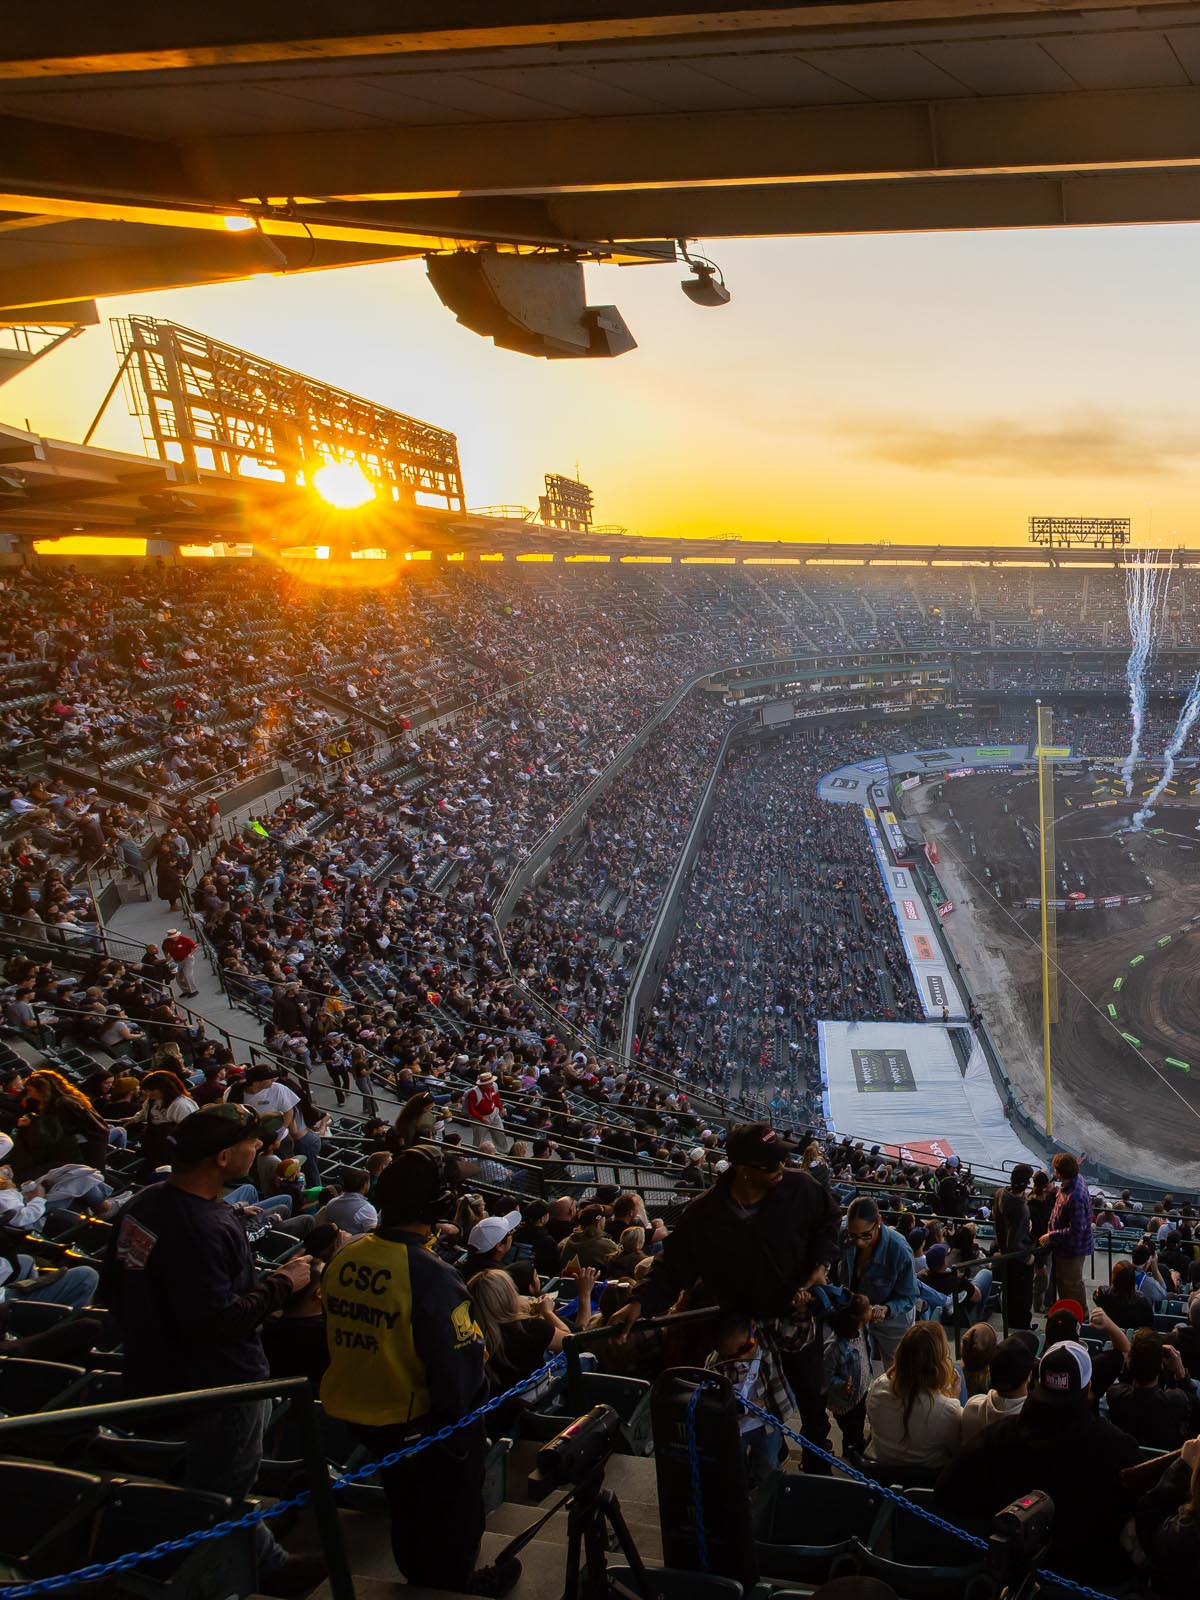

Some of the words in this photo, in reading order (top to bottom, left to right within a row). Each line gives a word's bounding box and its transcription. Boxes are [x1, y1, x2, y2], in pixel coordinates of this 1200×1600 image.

[860, 1056, 872, 1084] MONSTER
[888, 1056, 901, 1084] MONSTER
[339, 1261, 391, 1296] CSC
